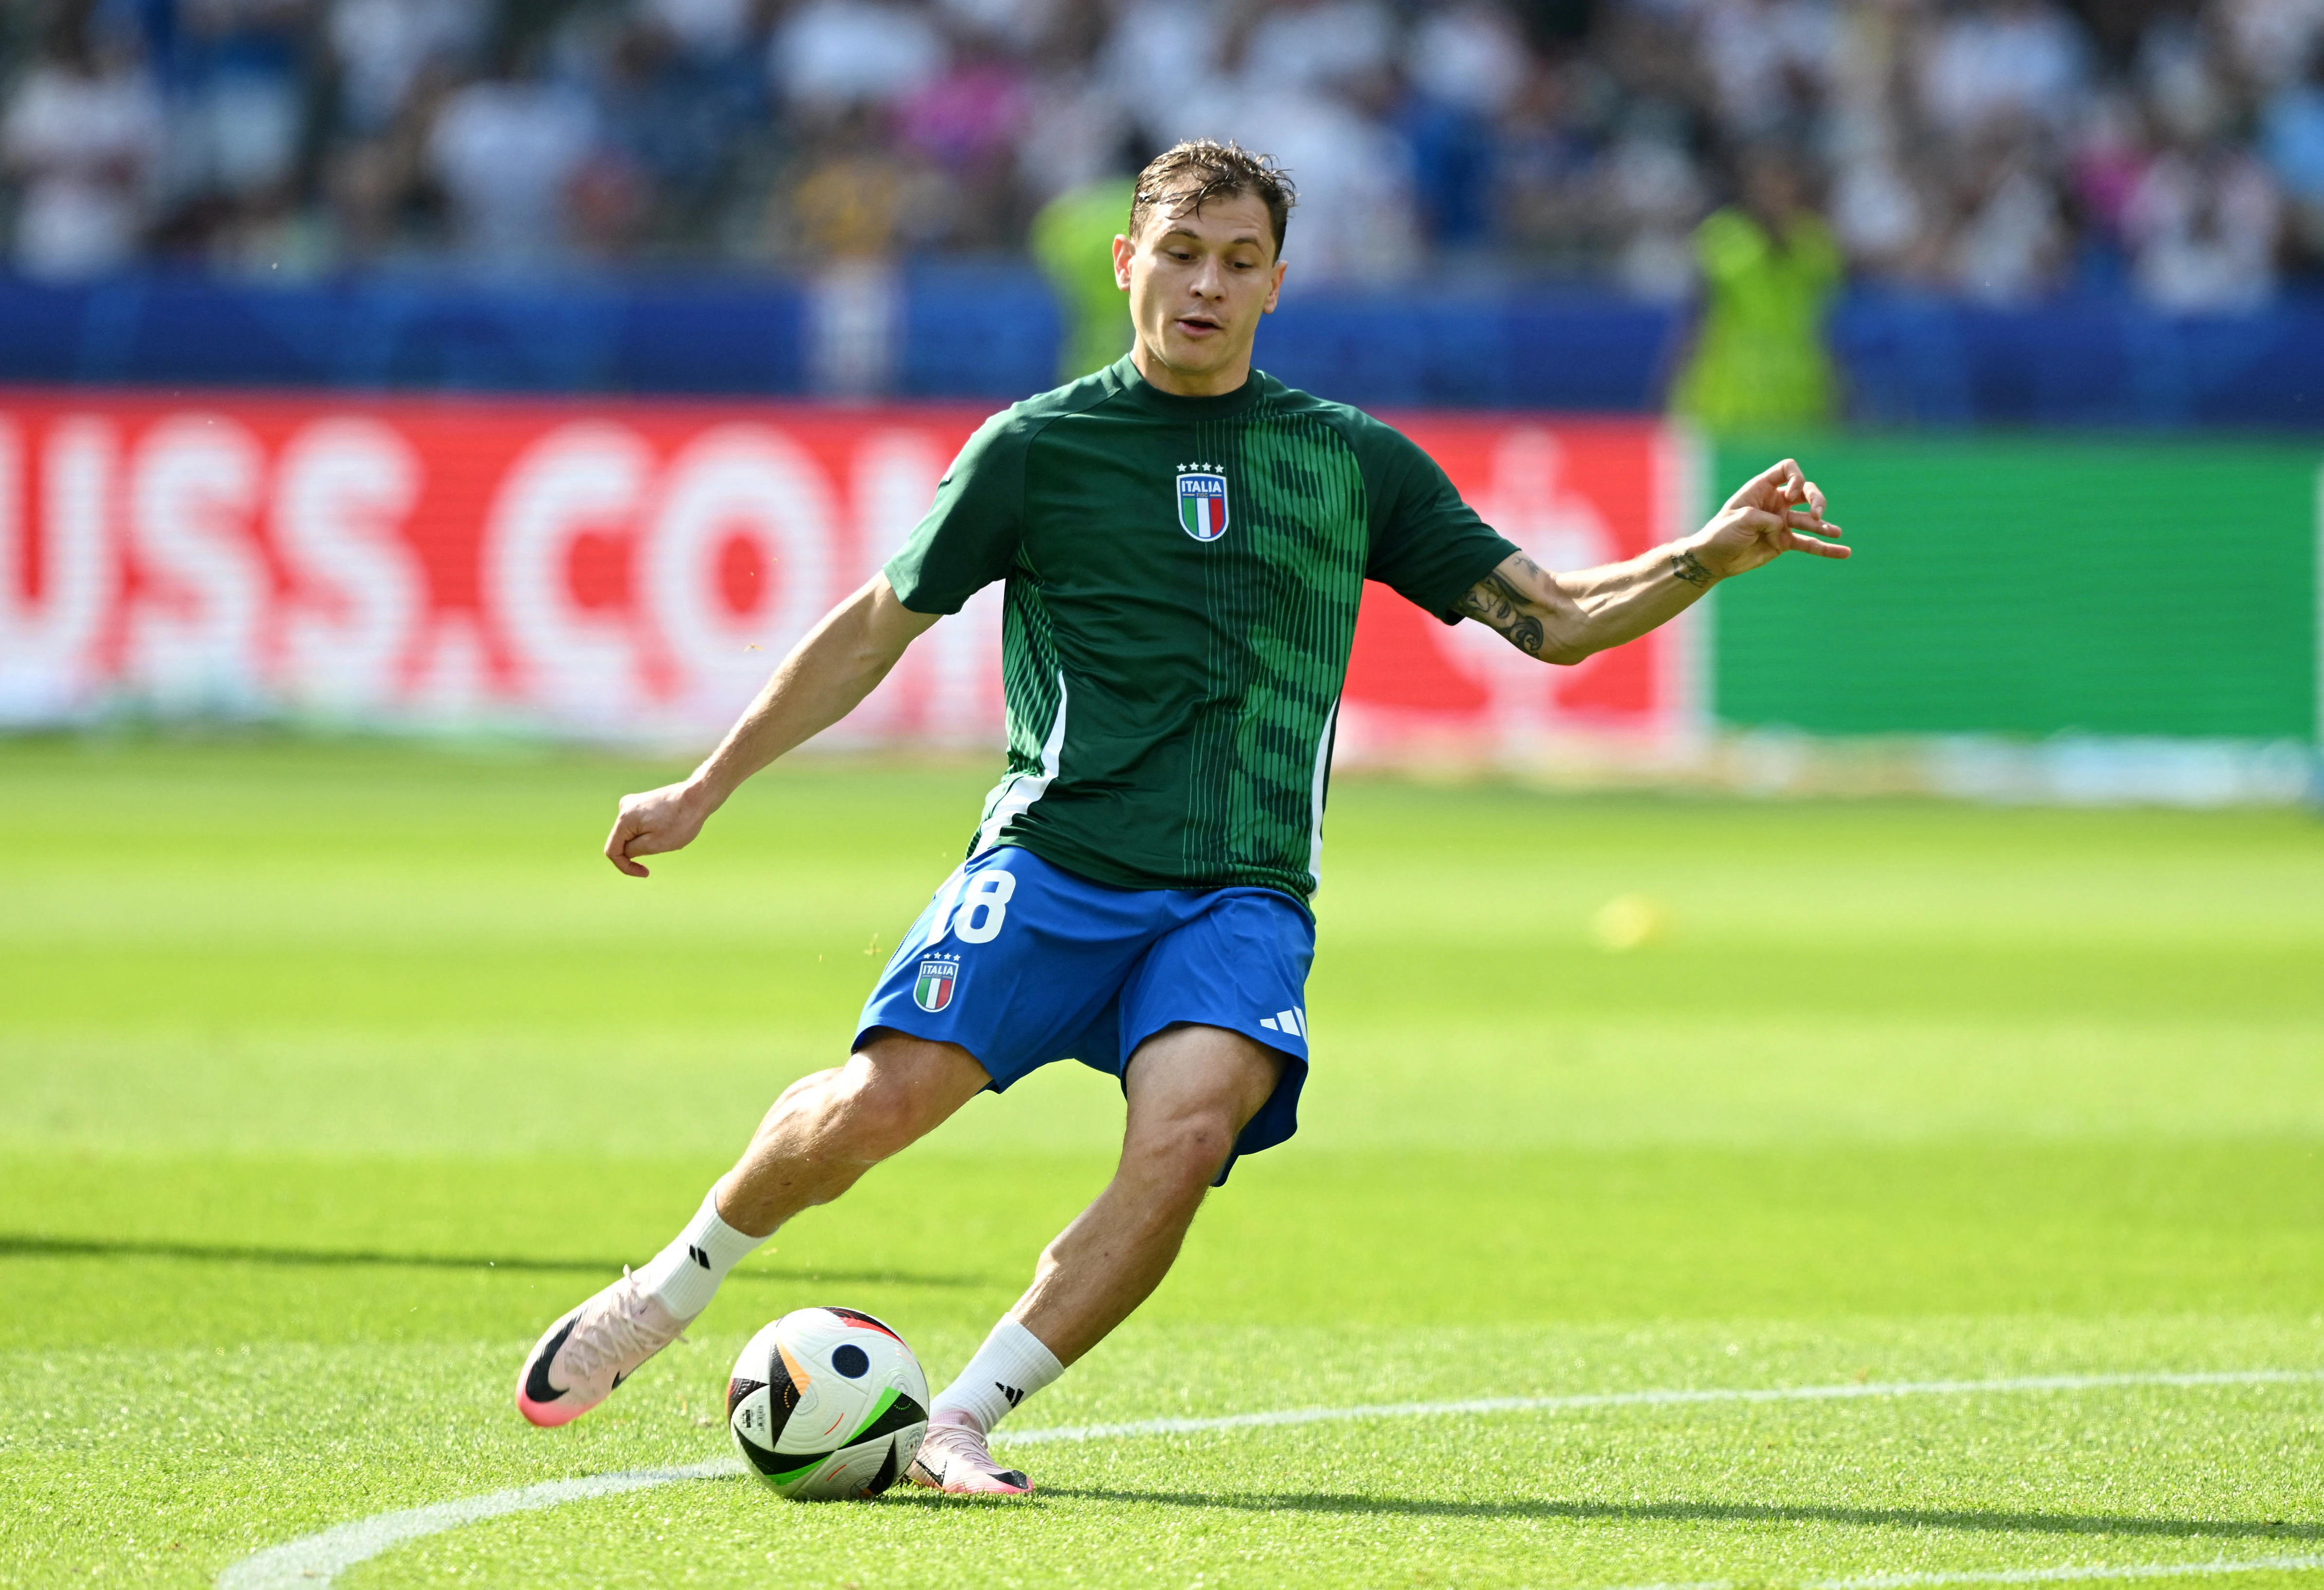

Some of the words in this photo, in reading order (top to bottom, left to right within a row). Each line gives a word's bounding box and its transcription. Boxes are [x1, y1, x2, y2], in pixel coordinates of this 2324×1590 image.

[1181, 480, 1222, 493] ITALIA
[925, 869, 1016, 944] 18
[922, 965, 954, 976] ITALIA
